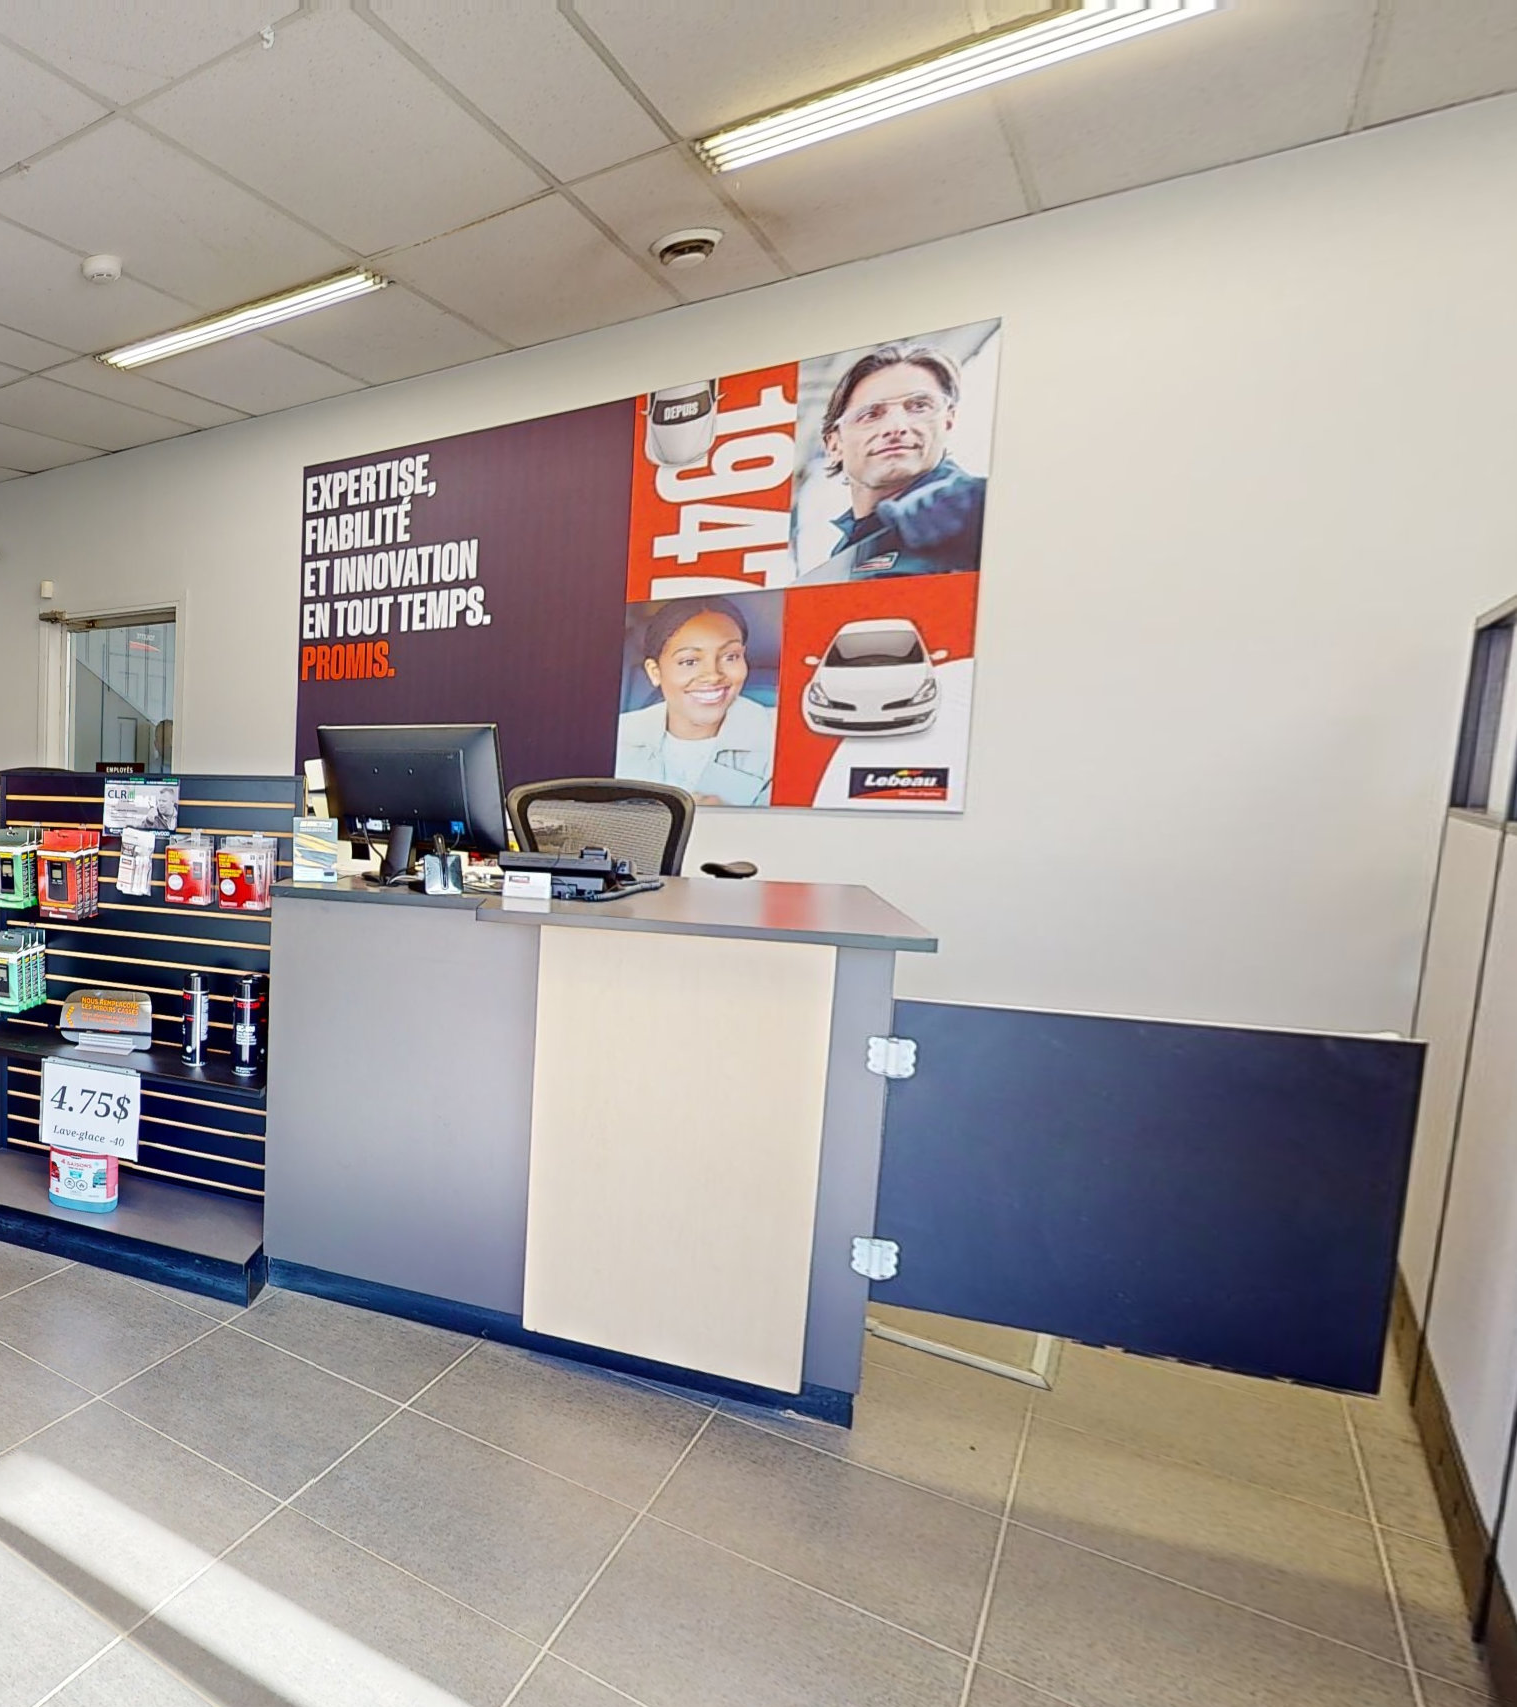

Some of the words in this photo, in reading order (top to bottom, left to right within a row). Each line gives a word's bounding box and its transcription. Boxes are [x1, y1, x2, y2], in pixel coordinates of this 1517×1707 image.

[664, 401, 699, 421] DEPUIS
[305, 453, 436, 514] EXPERTISE,
[305, 496, 411, 556] FIABILITÉ
[304, 560, 330, 598] ET
[332, 538, 479, 596] INNOVATION
[302, 602, 330, 640] EN
[334, 595, 394, 638] TOUT
[397, 586, 492, 632] TEMPS.
[301, 640, 396, 681] PROMIS.
[106, 765, 134, 774] EMPLOYÉS
[864, 773, 938, 787] Lebeau
[107, 789, 127, 799] CLR
[81, 997, 99, 1005] NOUS
[50, 1085, 131, 1123] 4.75$
[53, 1125, 106, 1143] Lave-glace
[109, 1137, 125, 1147] -40
